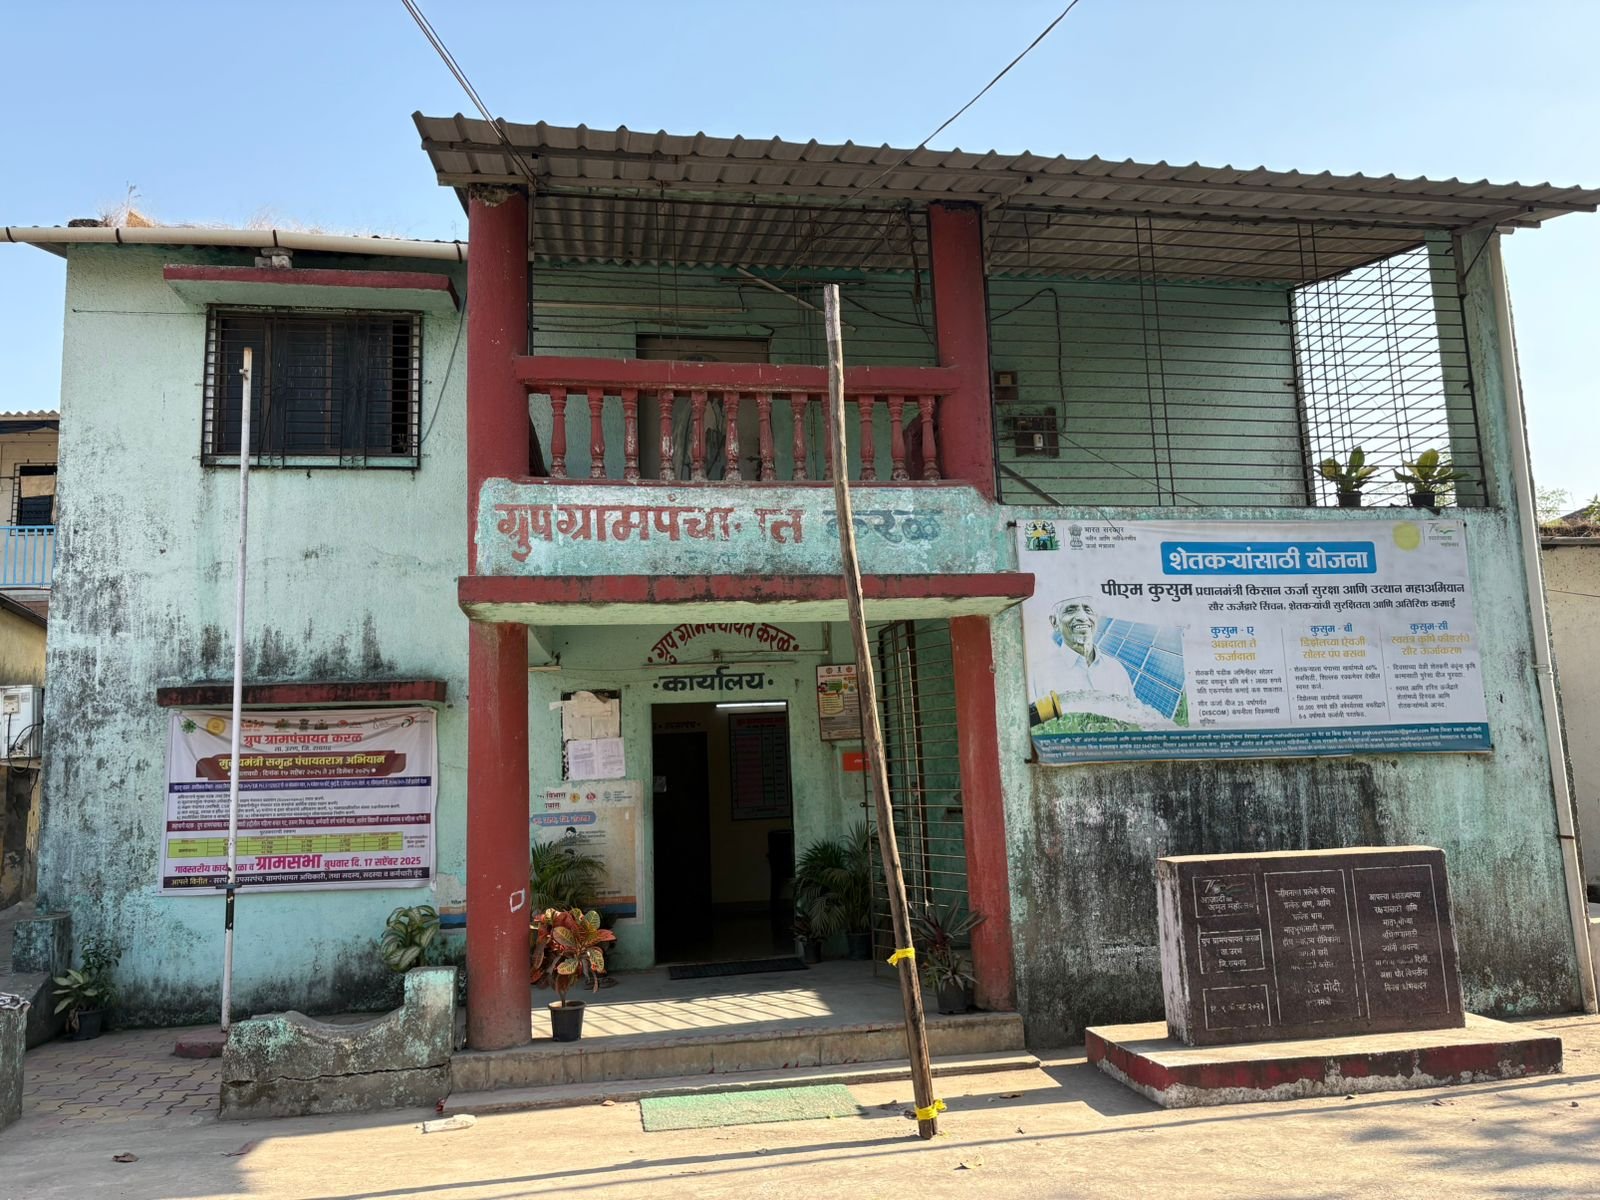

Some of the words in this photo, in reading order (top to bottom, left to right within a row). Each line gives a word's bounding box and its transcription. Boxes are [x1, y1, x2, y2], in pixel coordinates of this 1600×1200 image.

[557, 493, 806, 543] ग्रामपंचात
[1169, 546, 1300, 570] शेतकऱ्यांसाठी
[1305, 546, 1368, 569] योजना
[1101, 579, 1143, 599] पीएम
[1147, 583, 1193, 602] कुसुम
[1195, 584, 1243, 597] प्रधानमंत्री
[1246, 584, 1281, 596] किसान
[1284, 583, 1309, 596] ऊर्जा
[1312, 584, 1340, 599] सुरक्षा
[1343, 582, 1368, 595] आणि
[1371, 583, 1402, 595] उत्थान
[1405, 581, 1465, 594] महाअभियान
[1208, 601, 1224, 611] सौर
[1288, 599, 1331, 611] शेतकऱ्यांची
[1333, 599, 1371, 613] सुरक्षितता
[1373, 599, 1393, 609] आणि
[1431, 597, 1456, 609] कमाई
[756, 622, 797, 652] करळ
[1210, 626, 1238, 638] कुसुम
[1247, 626, 1255, 636] ए
[1310, 625, 1336, 636] कुसुम
[658, 664, 766, 692] कार्यालय
[1199, 708, 1230, 717] (DISCOM)
[243, 735, 262, 748] ग्रुप
[264, 732, 329, 745] ग्रामपंचायत
[331, 732, 363, 743] करळ
[266, 756, 293, 770] समृद्ध
[295, 753, 344, 766] पंचायतराज
[345, 752, 385, 765] अभियान
[255, 854, 323, 871] ग्रामसभा
[324, 859, 349, 870] बुधवार
[351, 857, 361, 867] दि.
[400, 857, 421, 866] 2025
[172, 877, 188, 886] आपले
[190, 876, 208, 885] विनीत
[266, 873, 298, 882] ग्रामपंचायत
[300, 871, 328, 880] अधिकारी,
[329, 872, 341, 880] तथा
